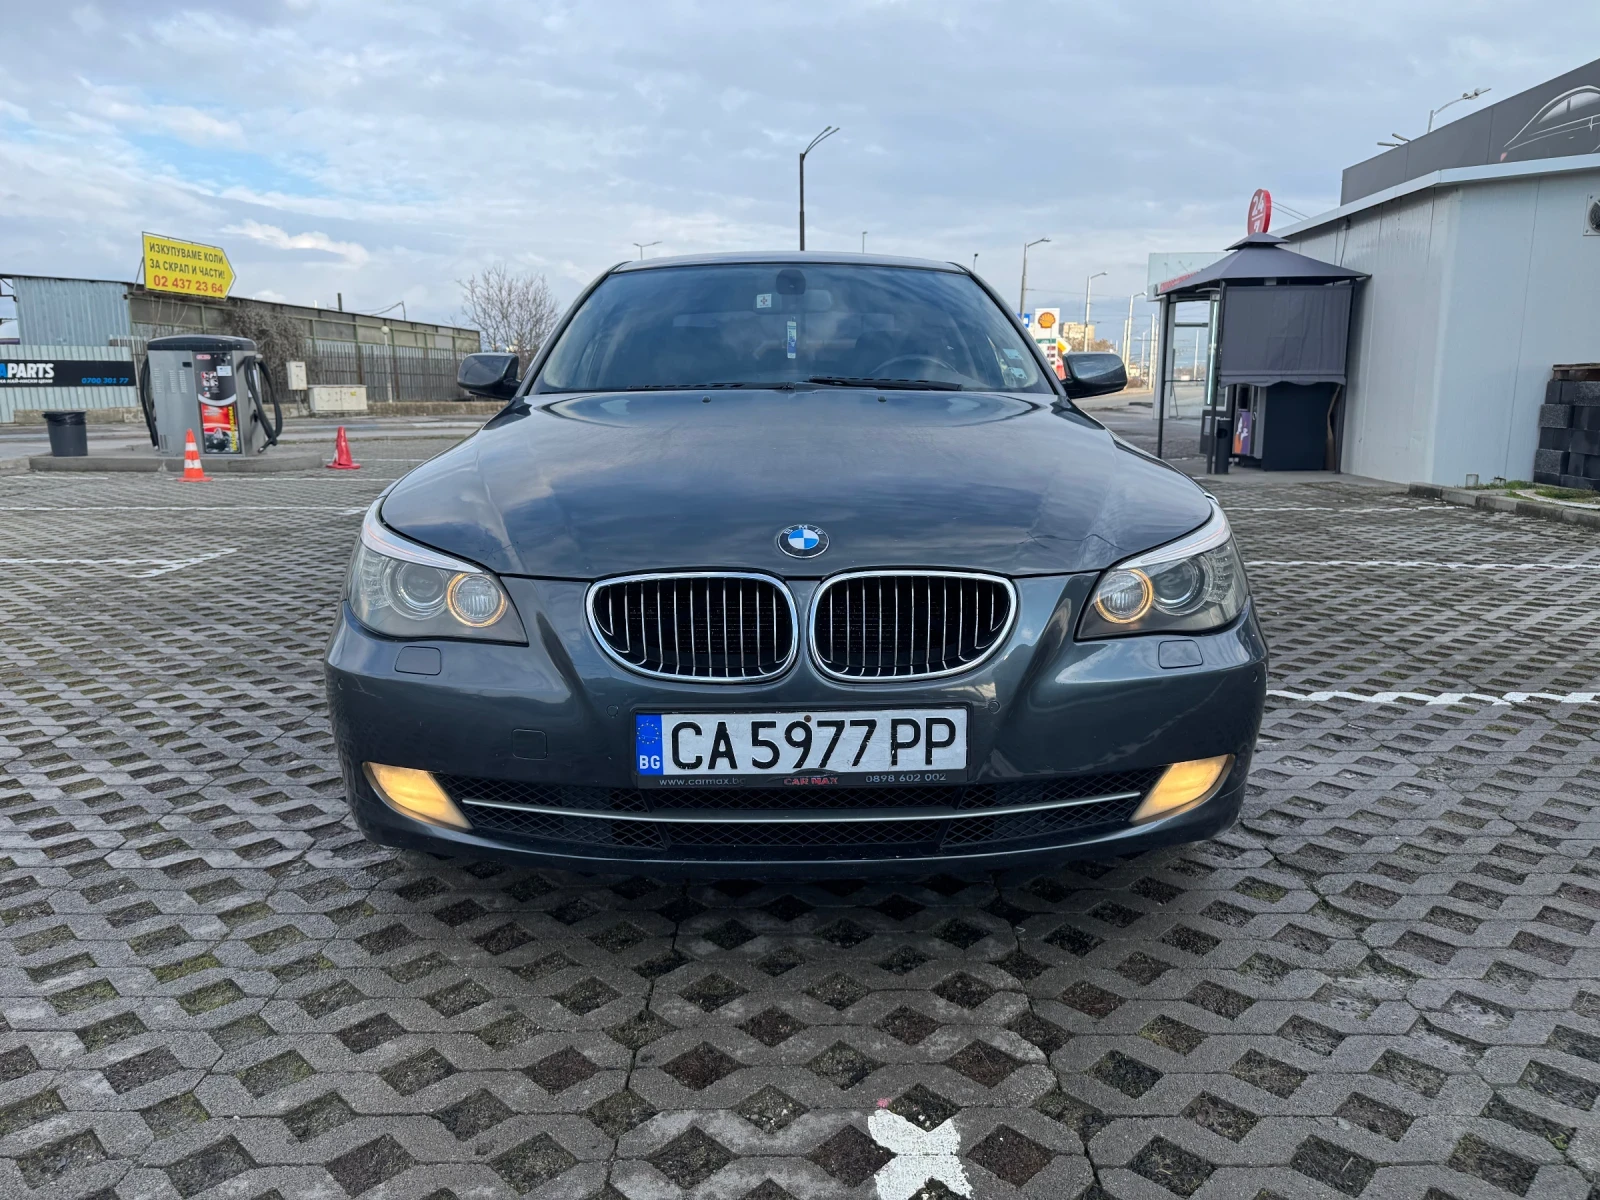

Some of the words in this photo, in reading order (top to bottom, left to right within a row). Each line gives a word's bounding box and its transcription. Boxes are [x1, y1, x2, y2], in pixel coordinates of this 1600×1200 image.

[1252, 192, 1264, 216] 24
[149, 242, 202, 260] ИЗКУПУВАМЕ
[204, 252, 224, 264] КОЛИ
[149, 259, 161, 270] ЗА
[163, 261, 190, 274] СКРАП
[191, 265, 197, 275] И
[199, 266, 226, 279] ЧАСТИ!
[153, 275, 168, 287] 02
[172, 278, 192, 289] 437
[195, 280, 208, 292] 23
[211, 283, 224, 294] 64
[783, 525, 824, 535] BMW
[671, 721, 738, 769] CA
[751, 719, 877, 769] 5977
[890, 717, 956, 766] PP
[639, 755, 660, 770] BG
[659, 777, 747, 786] www.carmax.bg
[866, 775, 895, 783] 0898
[900, 774, 921, 782] 602
[924, 773, 947, 781] 002
